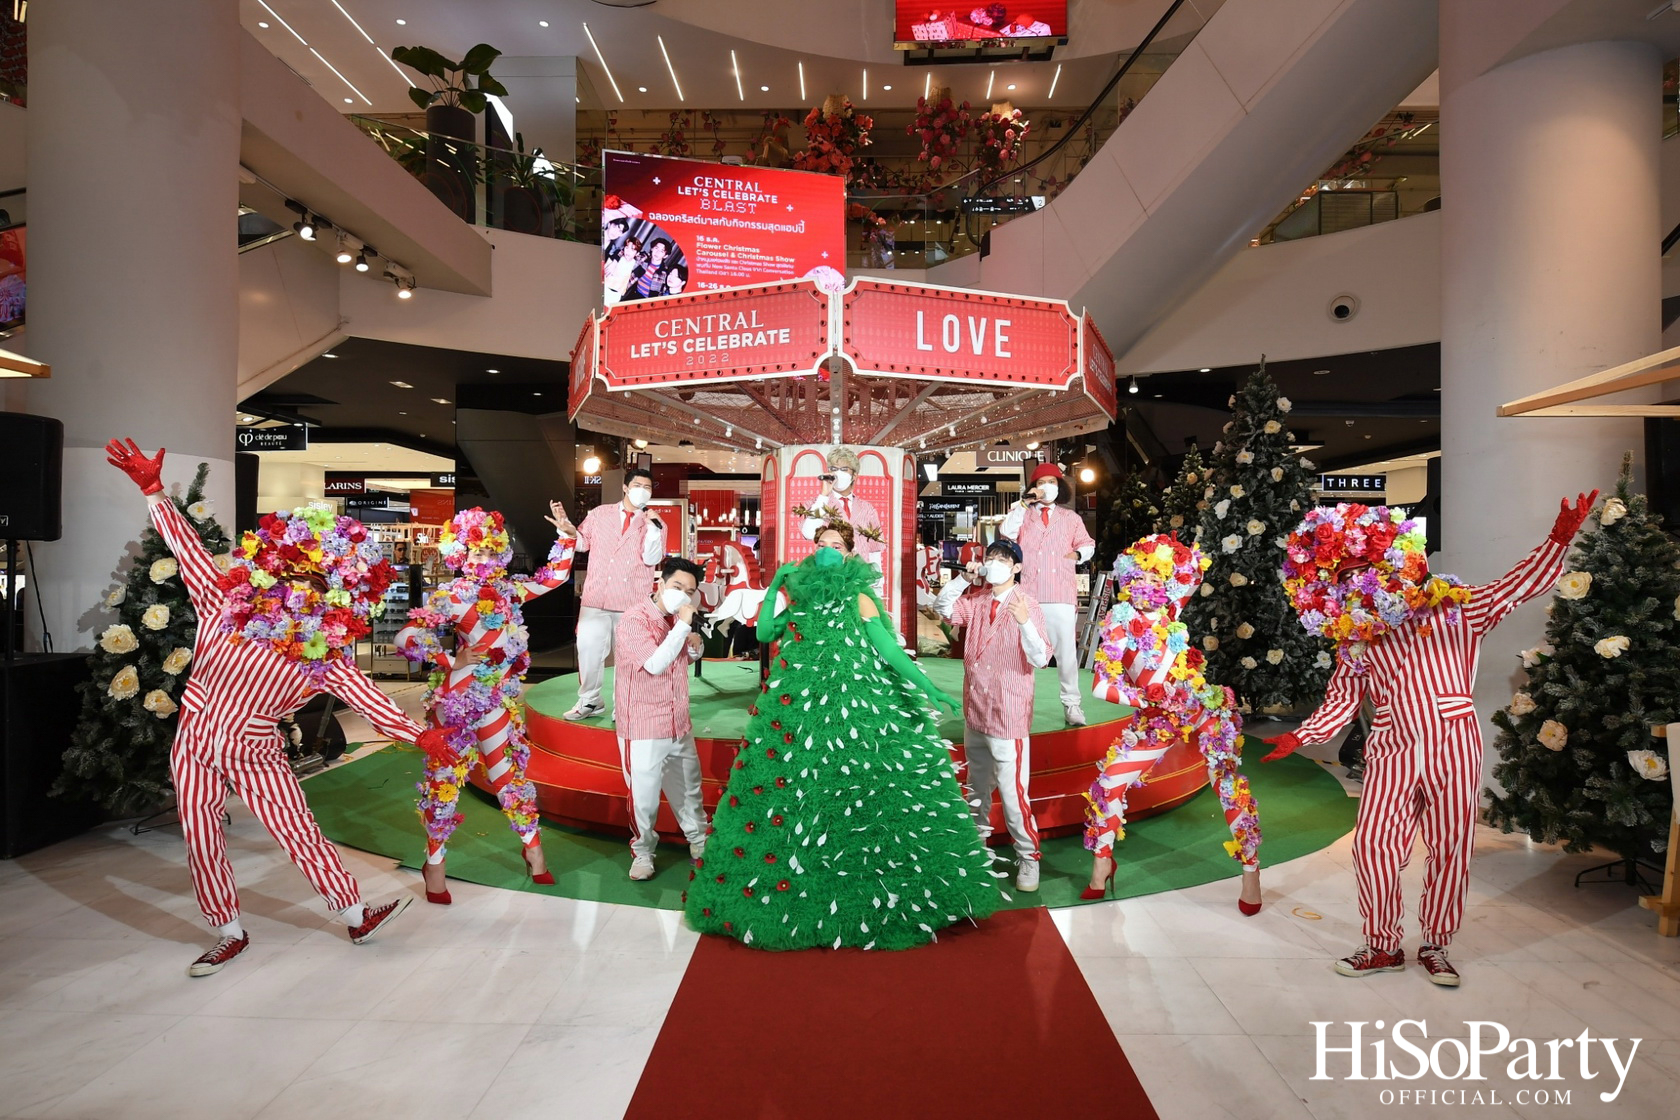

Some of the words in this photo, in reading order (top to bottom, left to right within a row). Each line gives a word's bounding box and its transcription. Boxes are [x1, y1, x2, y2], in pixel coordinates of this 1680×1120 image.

[694, 176, 763, 193] CENTRAL
[677, 186, 709, 197] LET'S
[713, 189, 778, 204] CELEBRATE
[700, 198, 757, 214] BLAST
[696, 242, 721, 250] Flower
[723, 244, 760, 253] Christmas
[696, 249, 729, 257] Carousel
[738, 252, 774, 262] Christmas
[775, 255, 795, 263] Show
[654, 310, 764, 338] CENTRAL
[916, 310, 1012, 358] LOVE
[630, 340, 678, 359] LET'S
[682, 328, 791, 353] CELEBRATE
[686, 352, 730, 366] 2022
[324, 482, 362, 490] LARINS
[1327, 478, 1381, 488] THREE
